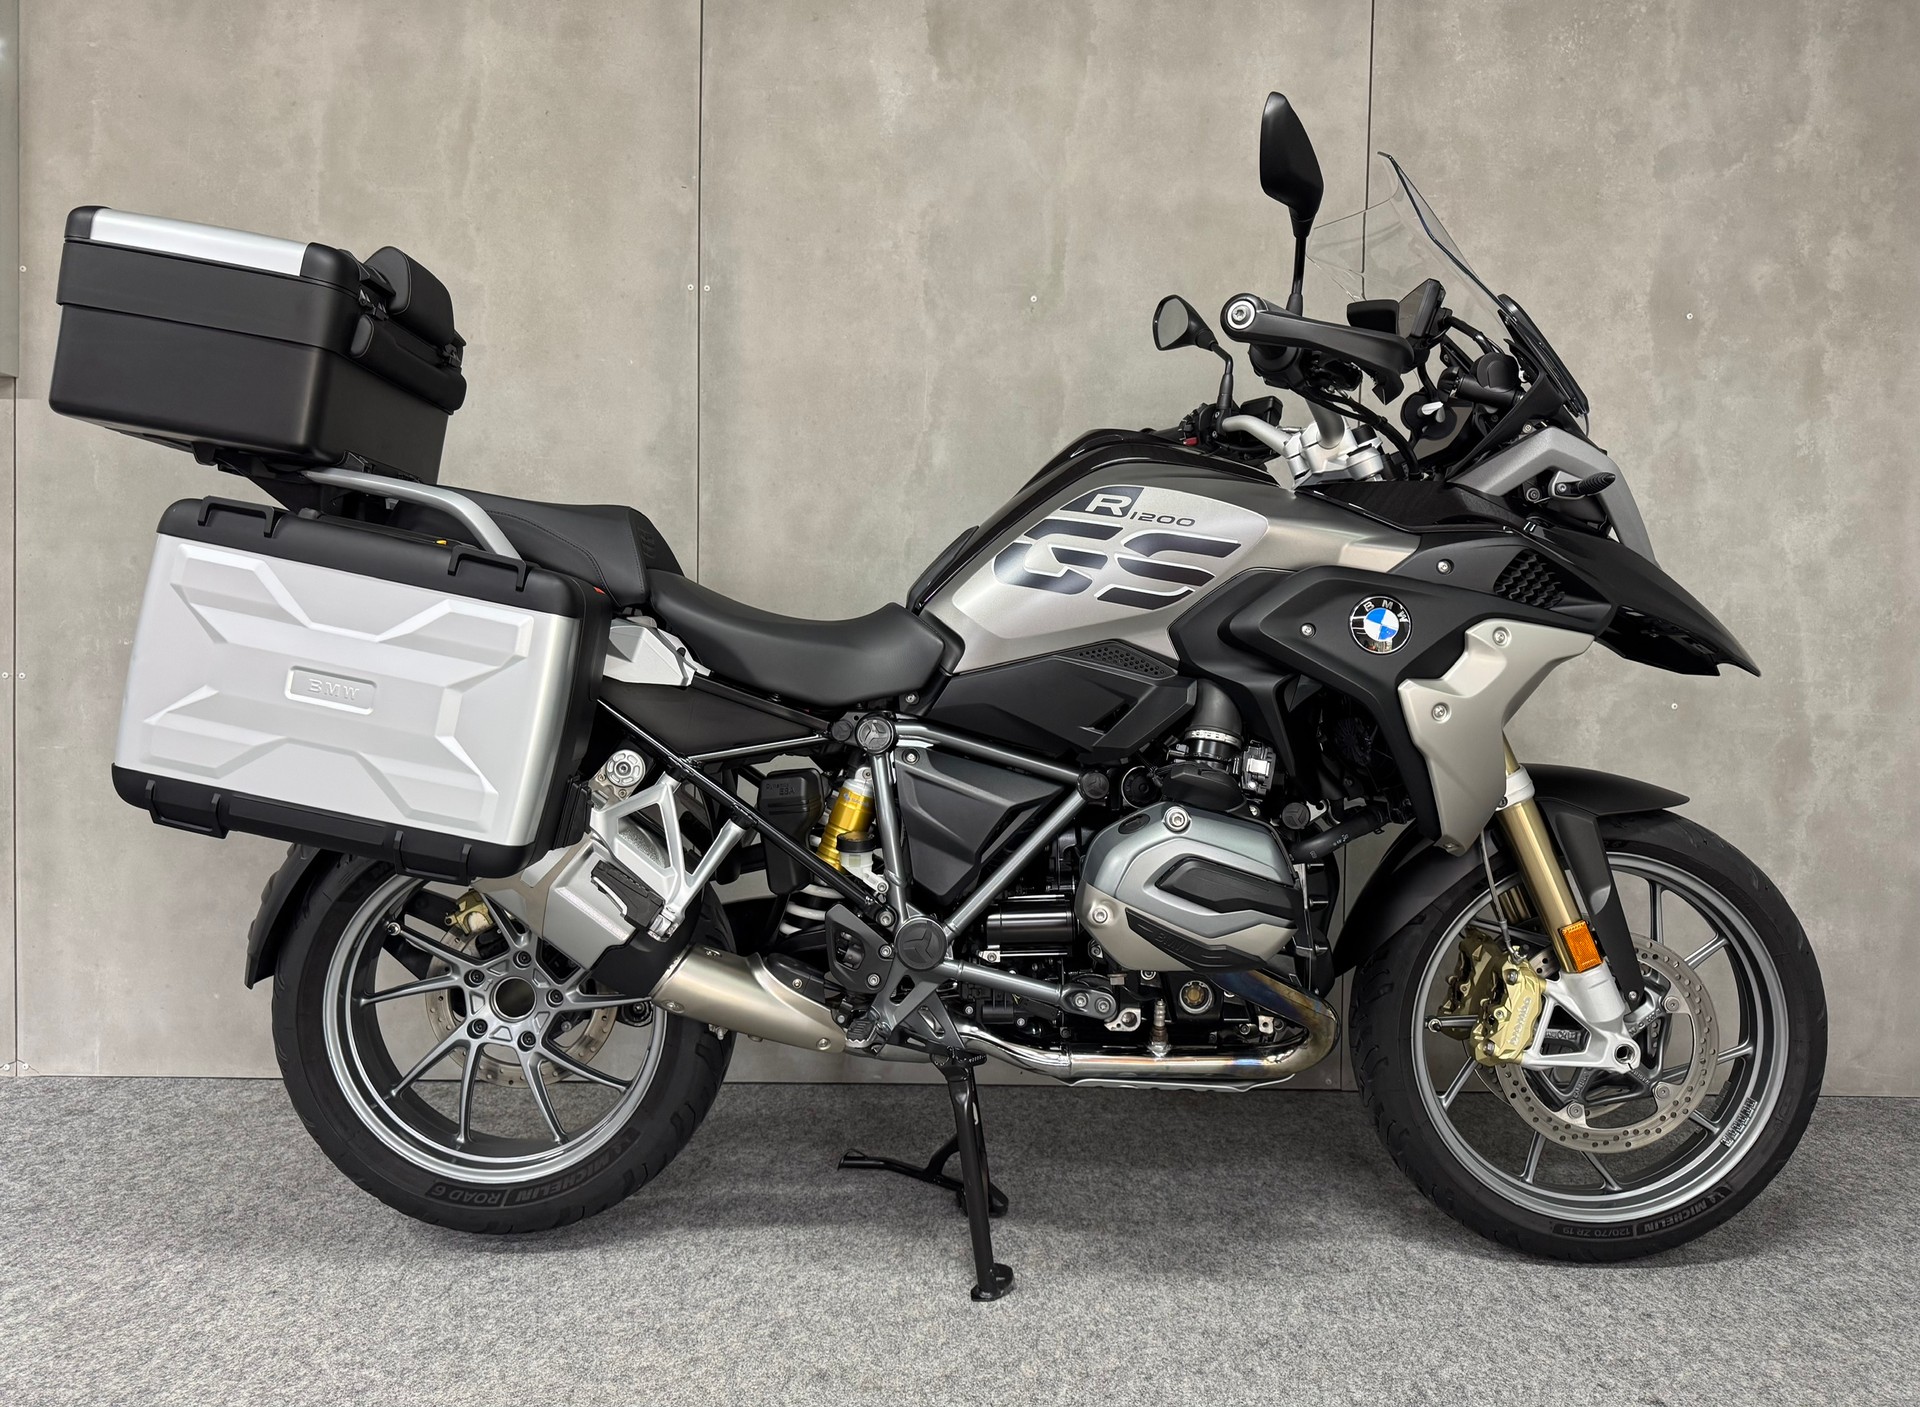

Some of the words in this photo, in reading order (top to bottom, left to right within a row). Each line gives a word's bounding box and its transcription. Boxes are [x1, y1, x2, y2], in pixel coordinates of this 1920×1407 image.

[1085, 493, 1132, 517] R
[1130, 512, 1195, 527] 1200
[992, 517, 1242, 611] GS
[1363, 599, 1409, 623] BMW
[308, 678, 360, 701] BMW
[433, 1183, 445, 1196] 6
[515, 1156, 610, 1202] MICHELIN
[451, 1188, 500, 1206] ROAD
[1644, 1202, 1708, 1233] MICHELIN
[1594, 1227, 1632, 1238] 120/70
